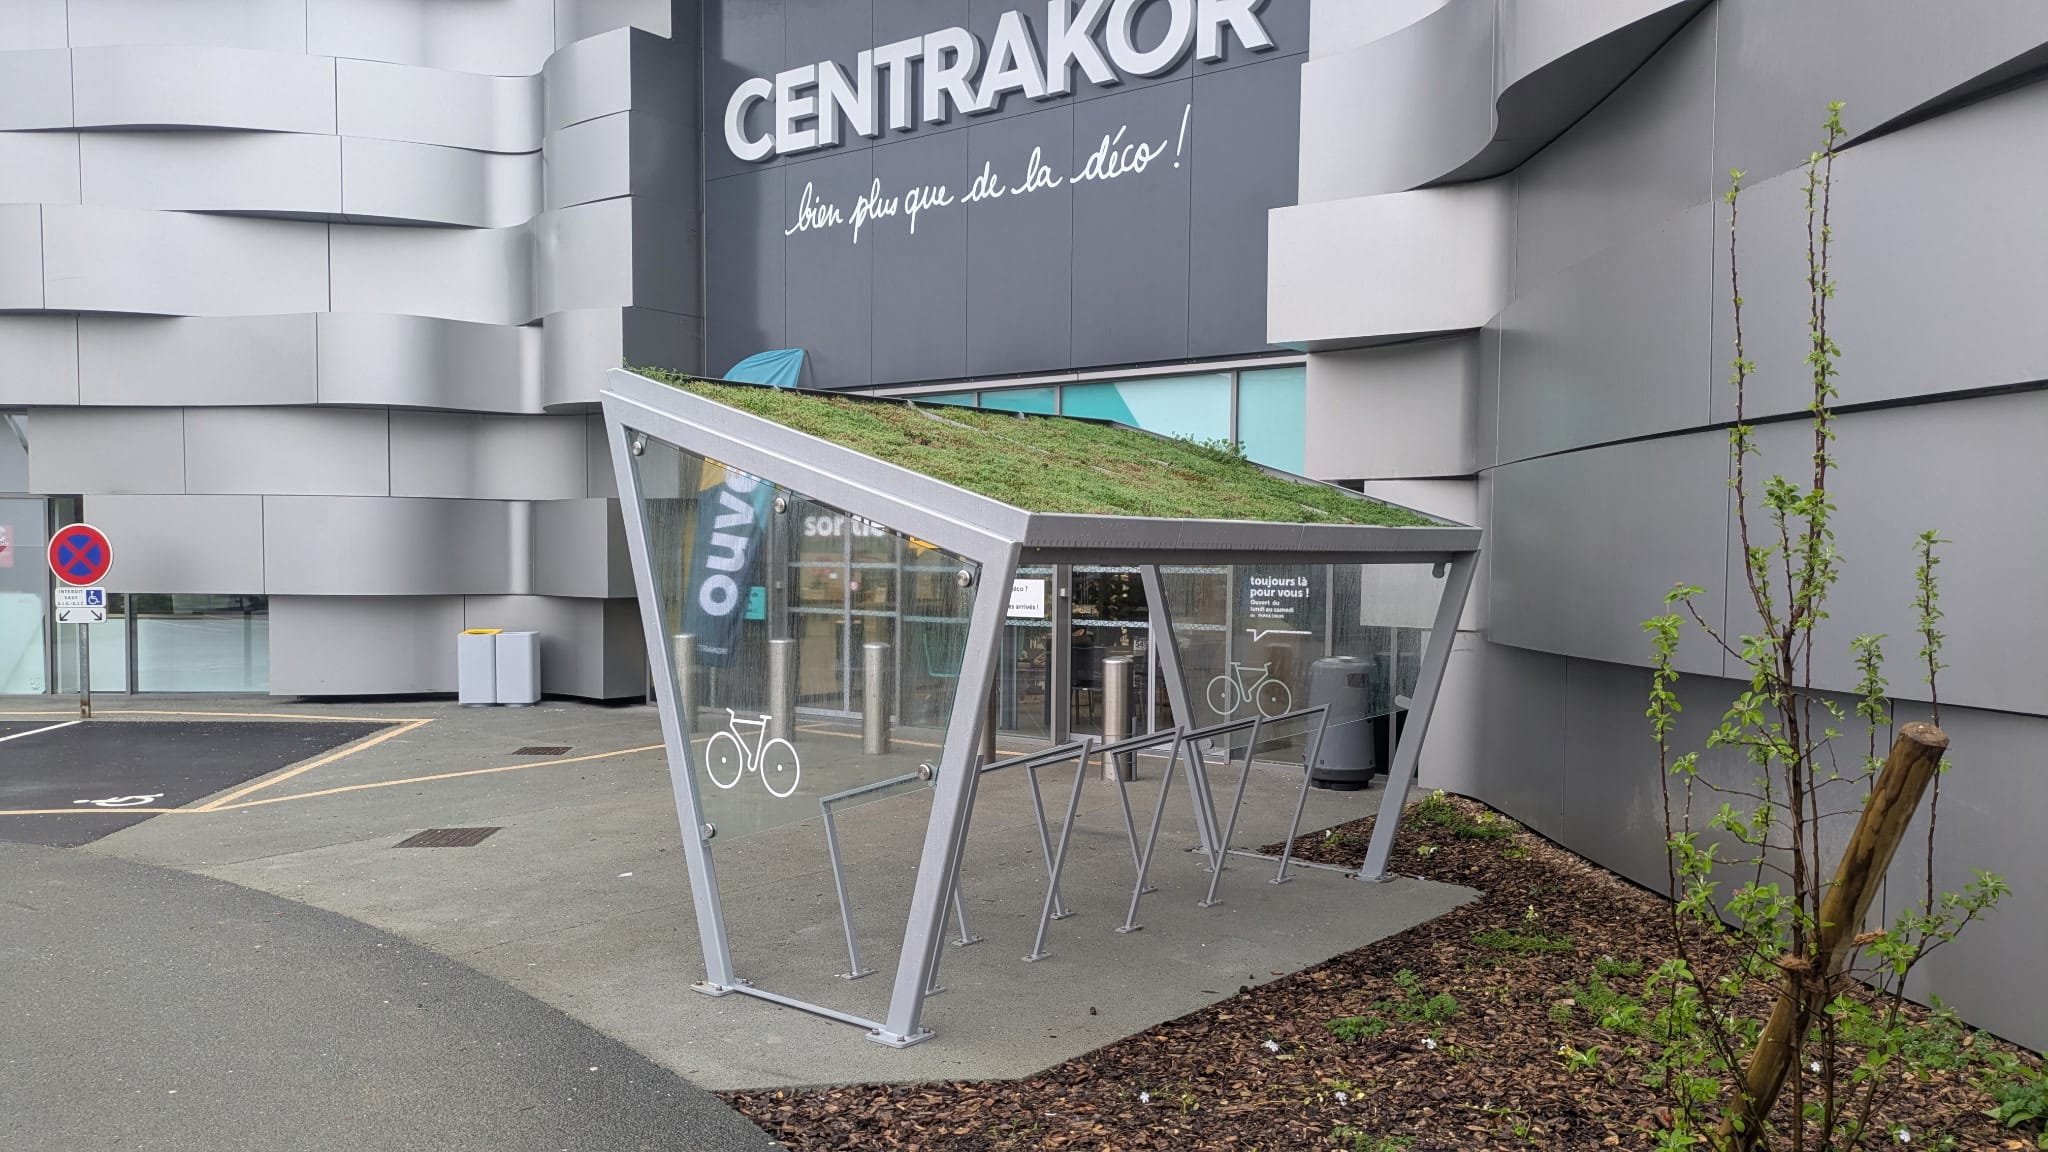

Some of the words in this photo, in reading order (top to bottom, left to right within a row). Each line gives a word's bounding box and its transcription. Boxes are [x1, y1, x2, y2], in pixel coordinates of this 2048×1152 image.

[723, 0, 1275, 163] CENTRAKOR
[785, 181, 844, 236] bien
[848, 177, 899, 244] plus
[903, 184, 954, 235] que
[960, 161, 1006, 204] de
[1011, 145, 1063, 195] la
[1069, 124, 1168, 184] déco
[699, 464, 760, 617] ouve
[1250, 575, 1296, 588] toujours
[1297, 576, 1308, 587] là
[1250, 588, 1276, 599] pour
[1277, 589, 1303, 598] vous
